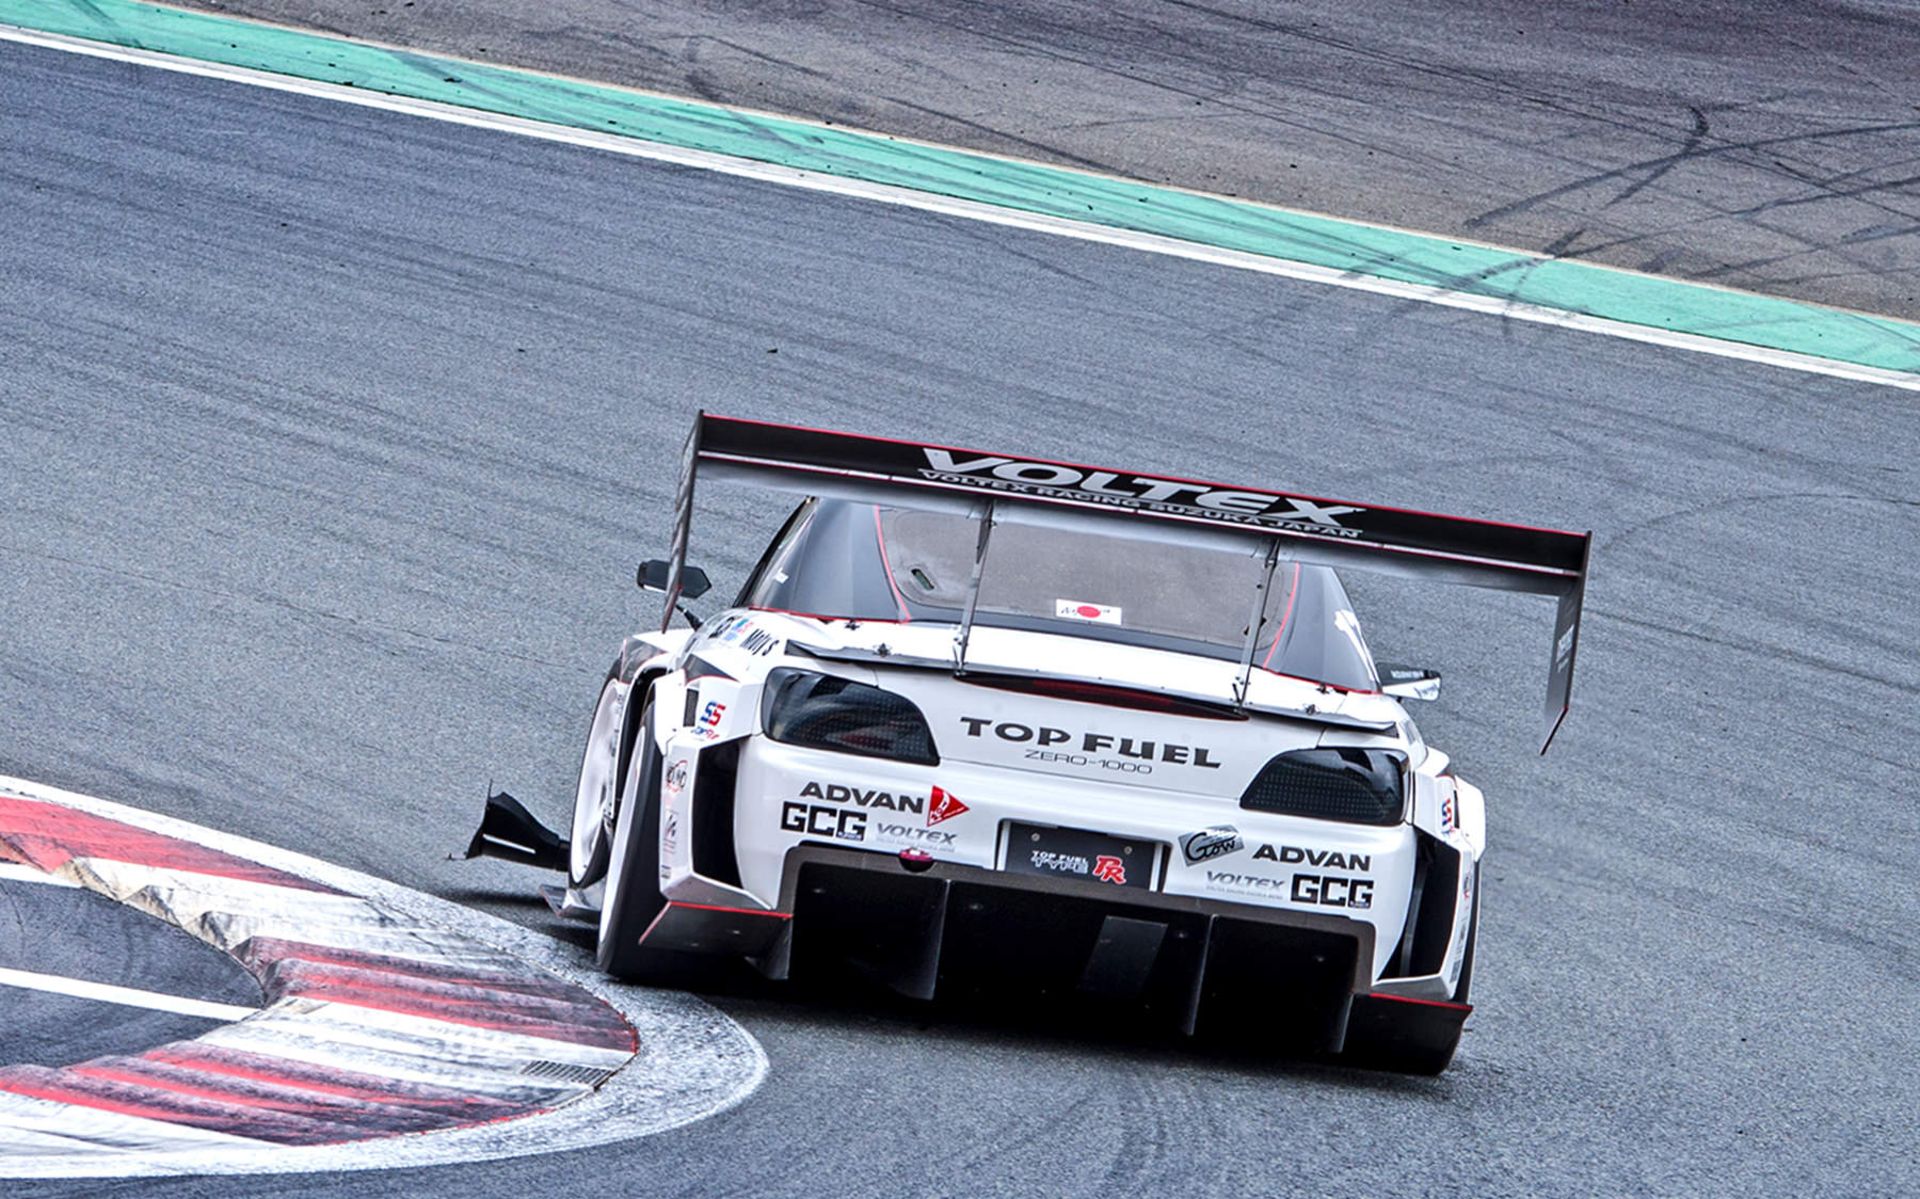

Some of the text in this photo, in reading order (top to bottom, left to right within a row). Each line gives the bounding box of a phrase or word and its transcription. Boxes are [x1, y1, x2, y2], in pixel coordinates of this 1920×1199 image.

[919, 470, 1363, 538] VOLTEX RACING SUZUKA JAPAN
[923, 448, 1368, 527] VOLTEX
[960, 716, 1221, 769] TOP FUEL
[1024, 748, 1153, 775] ZERO-1000
[800, 781, 925, 814] ADVAN
[780, 801, 867, 842] GCG
[877, 822, 958, 846] VOLTEX
[1252, 843, 1372, 872] ADVAN
[1206, 870, 1285, 890] VOLTEX
[1291, 873, 1374, 910] GCG
